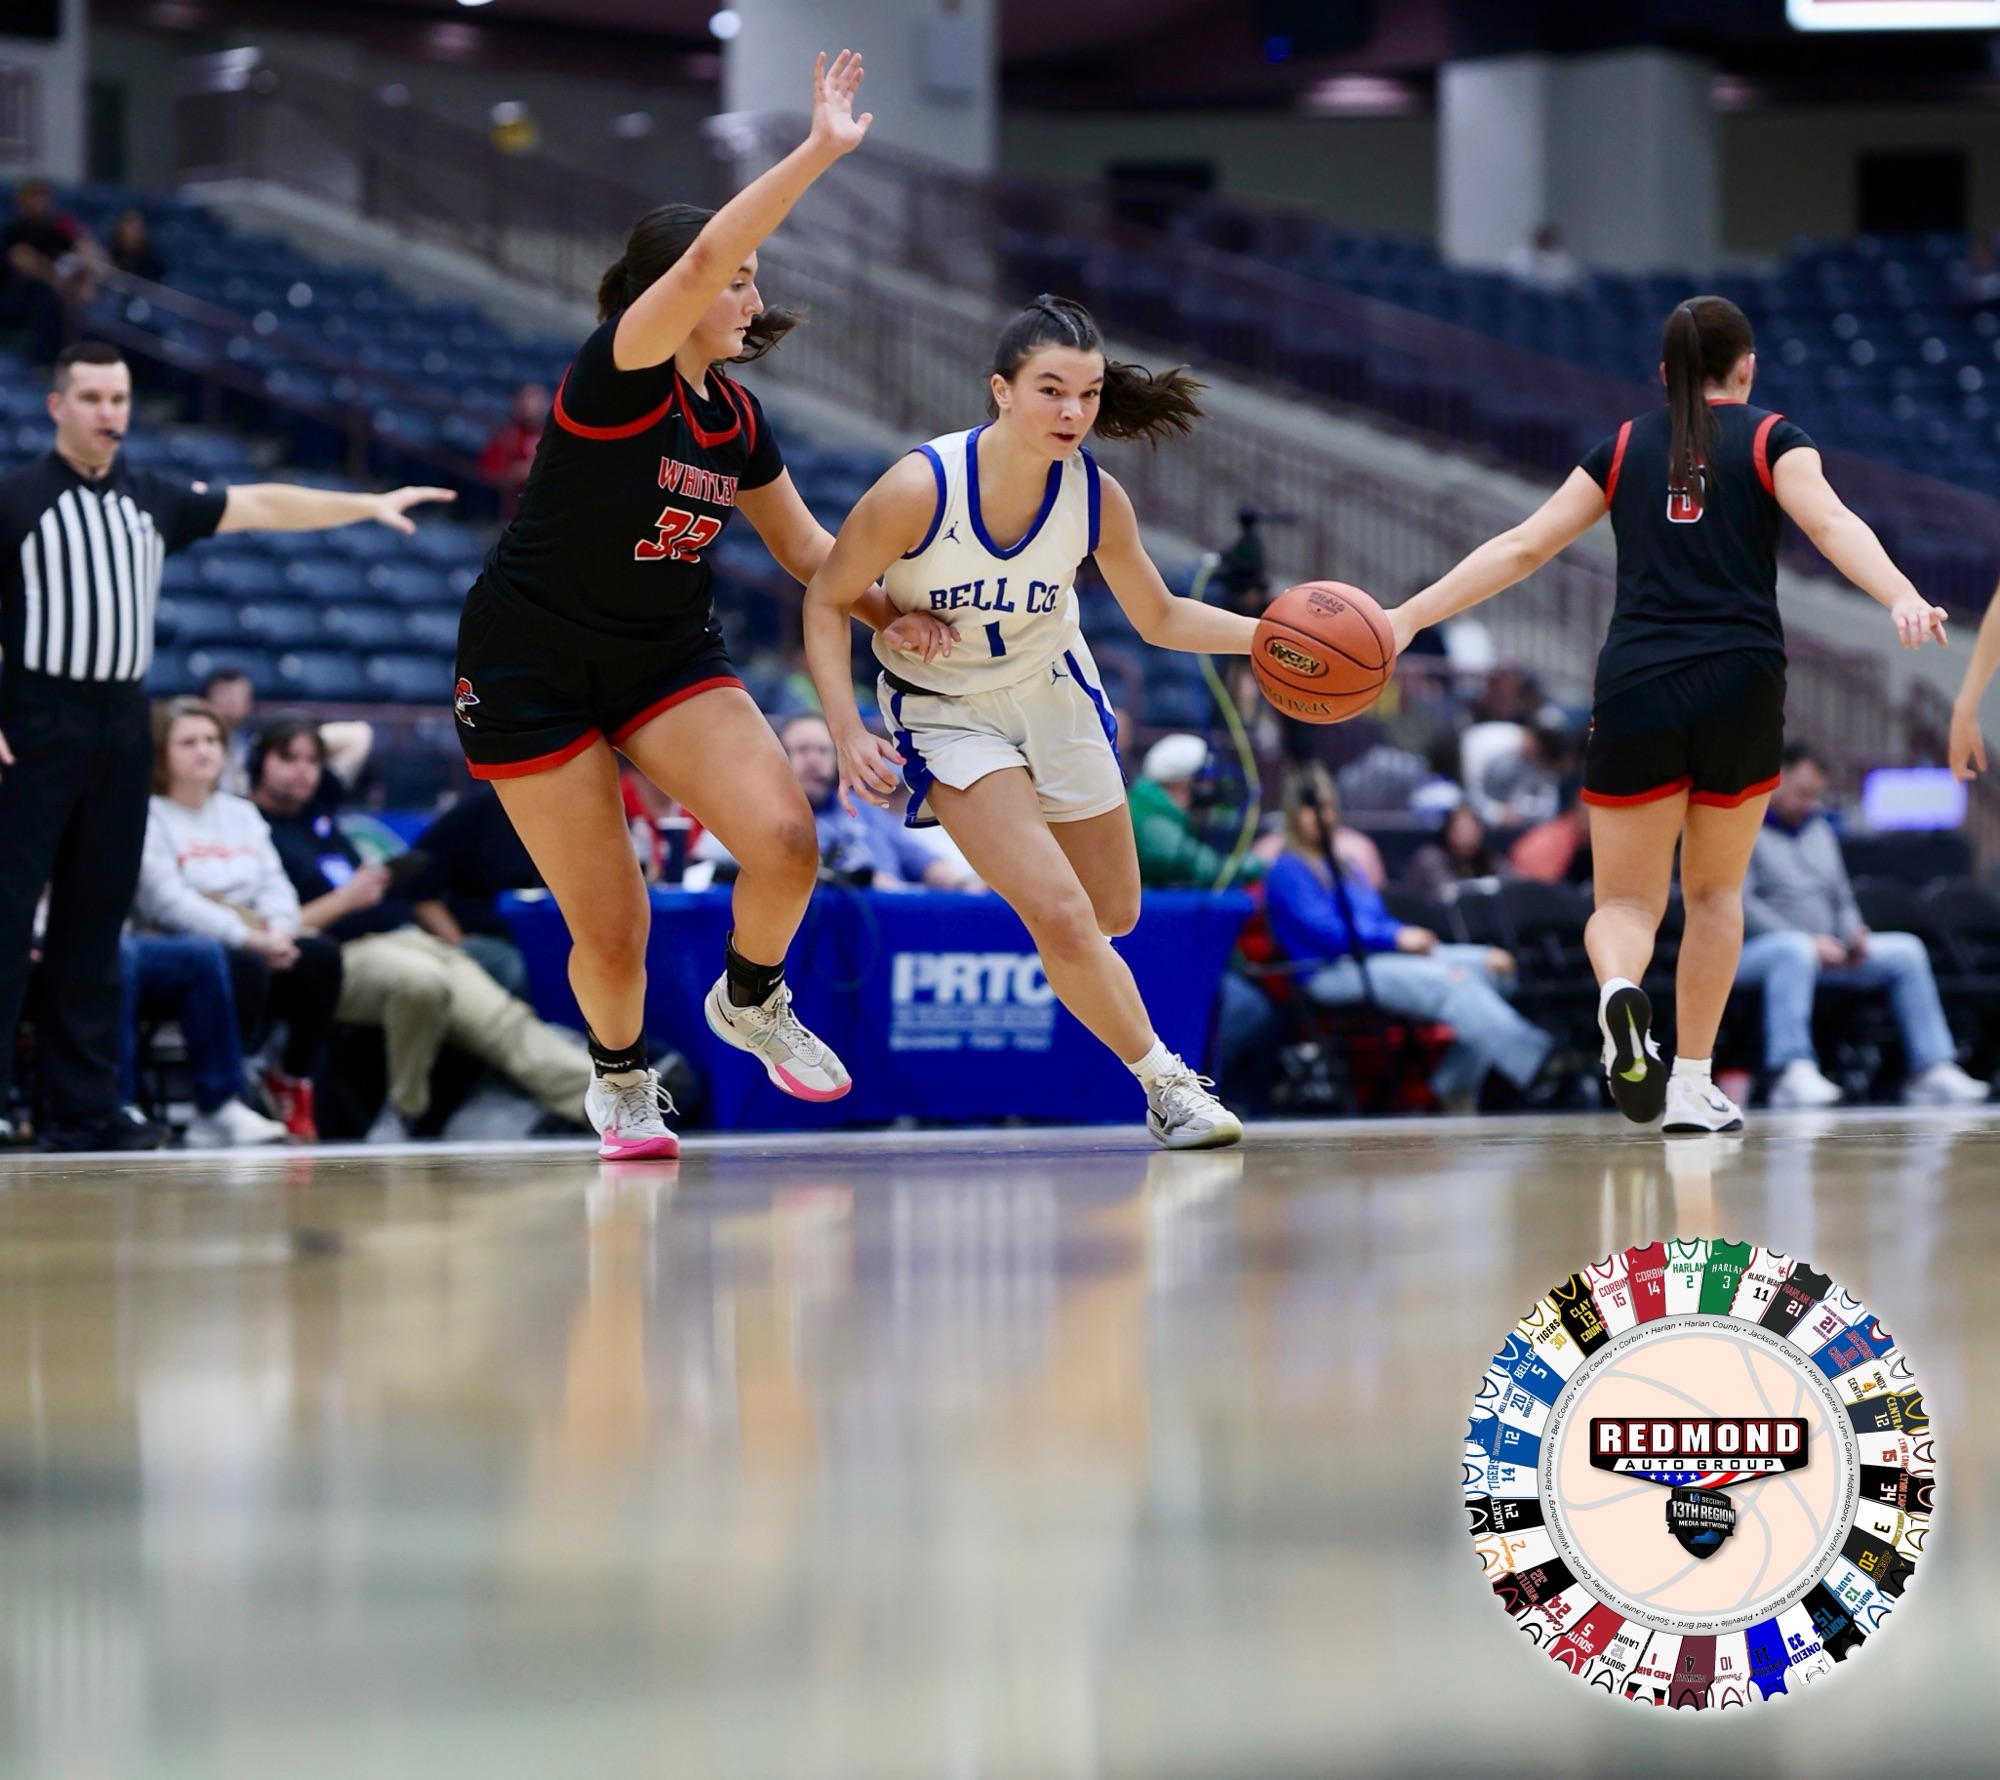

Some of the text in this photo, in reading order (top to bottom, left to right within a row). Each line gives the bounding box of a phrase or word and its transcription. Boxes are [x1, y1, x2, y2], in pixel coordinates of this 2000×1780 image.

[658, 456, 739, 507] WHITLEY
[634, 506, 722, 563] 32
[929, 577, 1015, 613] BELL
[983, 620, 1006, 658] 1
[892, 952, 1054, 1005] PRTC
